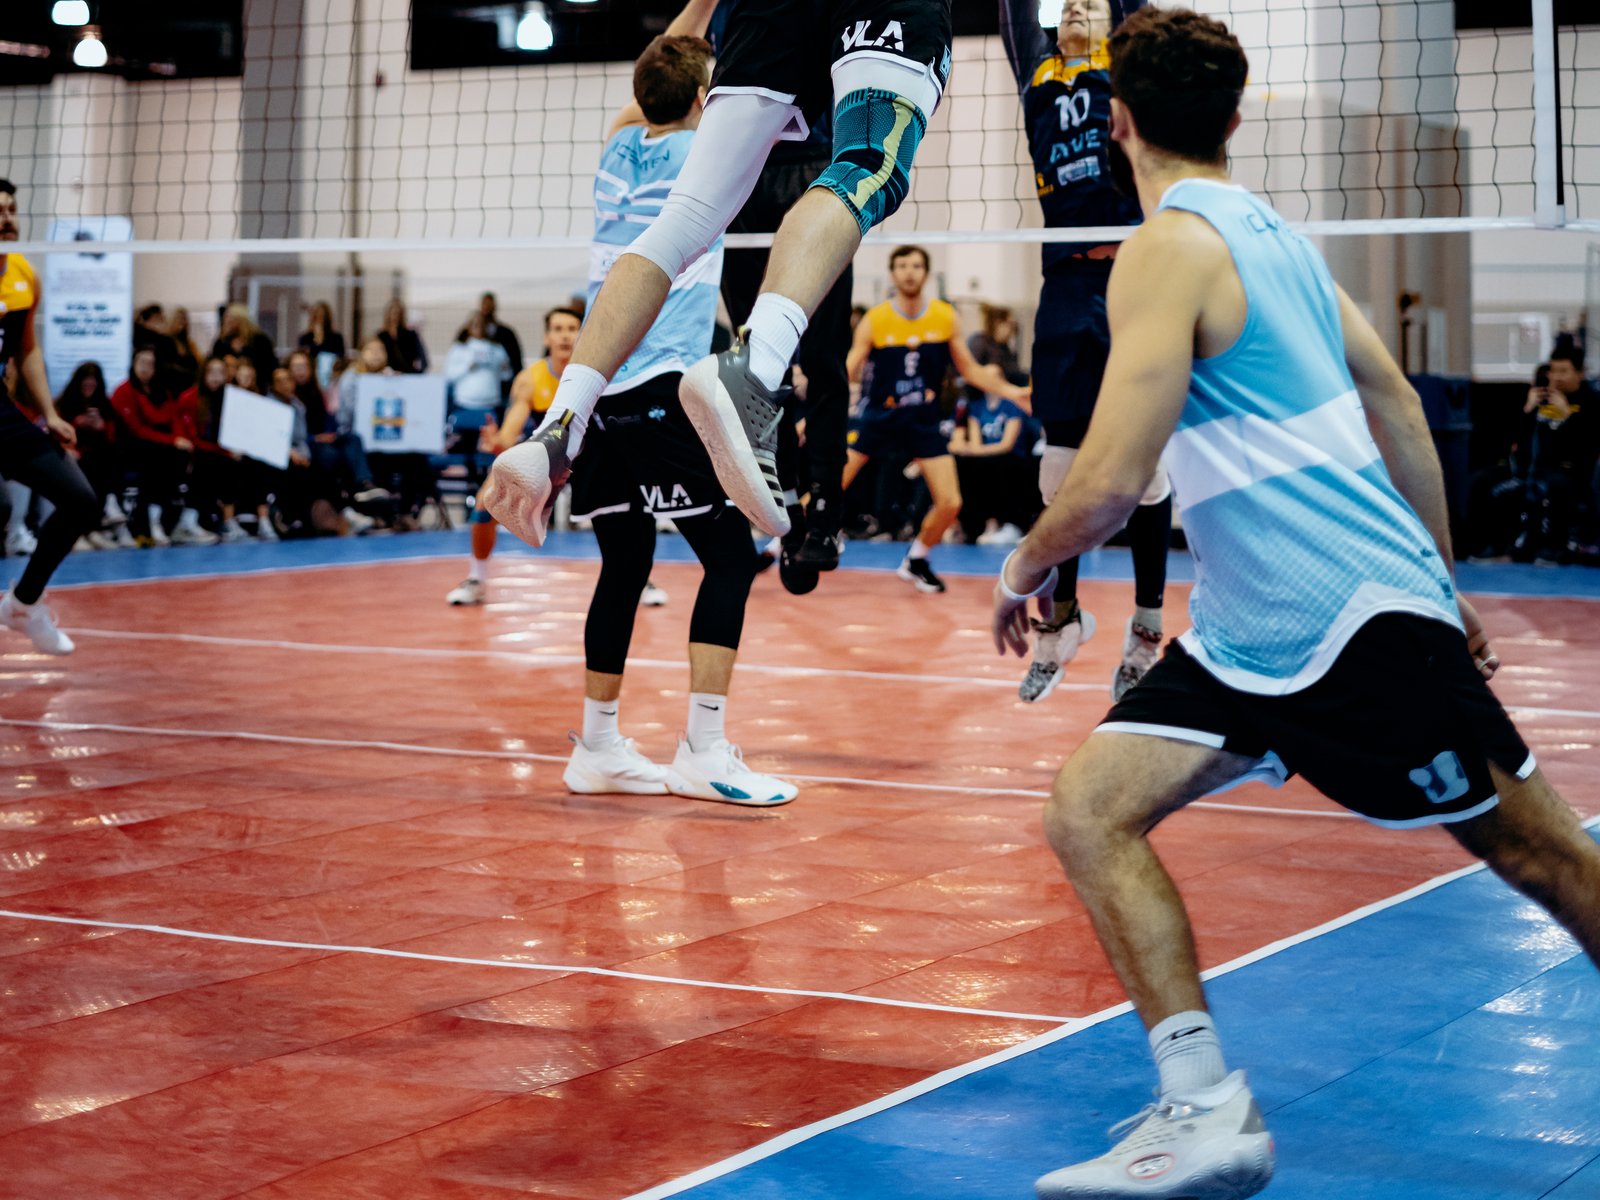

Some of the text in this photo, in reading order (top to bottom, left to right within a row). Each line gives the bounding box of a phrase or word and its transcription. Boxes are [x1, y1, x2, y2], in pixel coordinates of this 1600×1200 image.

[841, 19, 904, 53] VLA
[1055, 88, 1091, 131] 10
[639, 483, 693, 513] VLA
